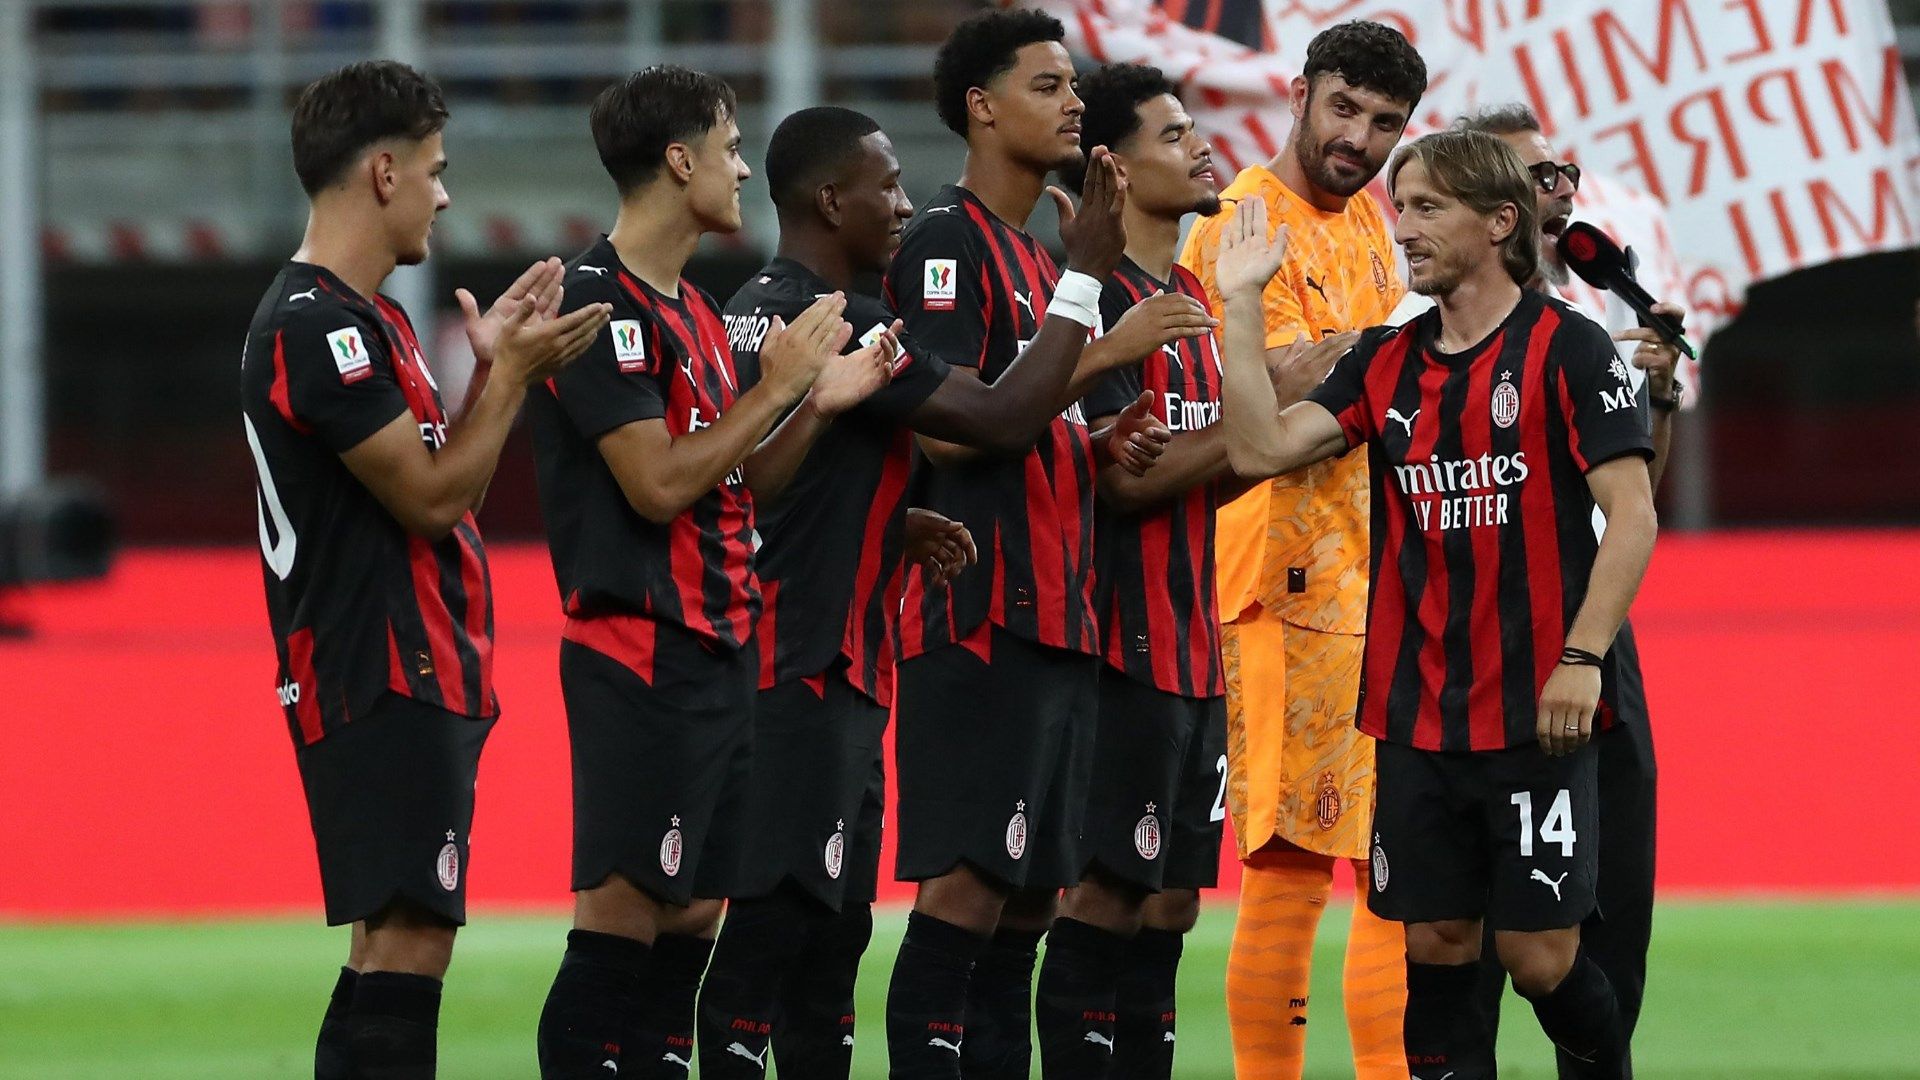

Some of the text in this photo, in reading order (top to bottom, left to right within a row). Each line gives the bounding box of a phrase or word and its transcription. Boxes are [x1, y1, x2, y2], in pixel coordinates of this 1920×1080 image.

[1394, 451, 1529, 495] mirates
[1440, 493, 1508, 531] BETTER
[1209, 753, 1228, 822] 2
[1511, 788, 1577, 857] 14
